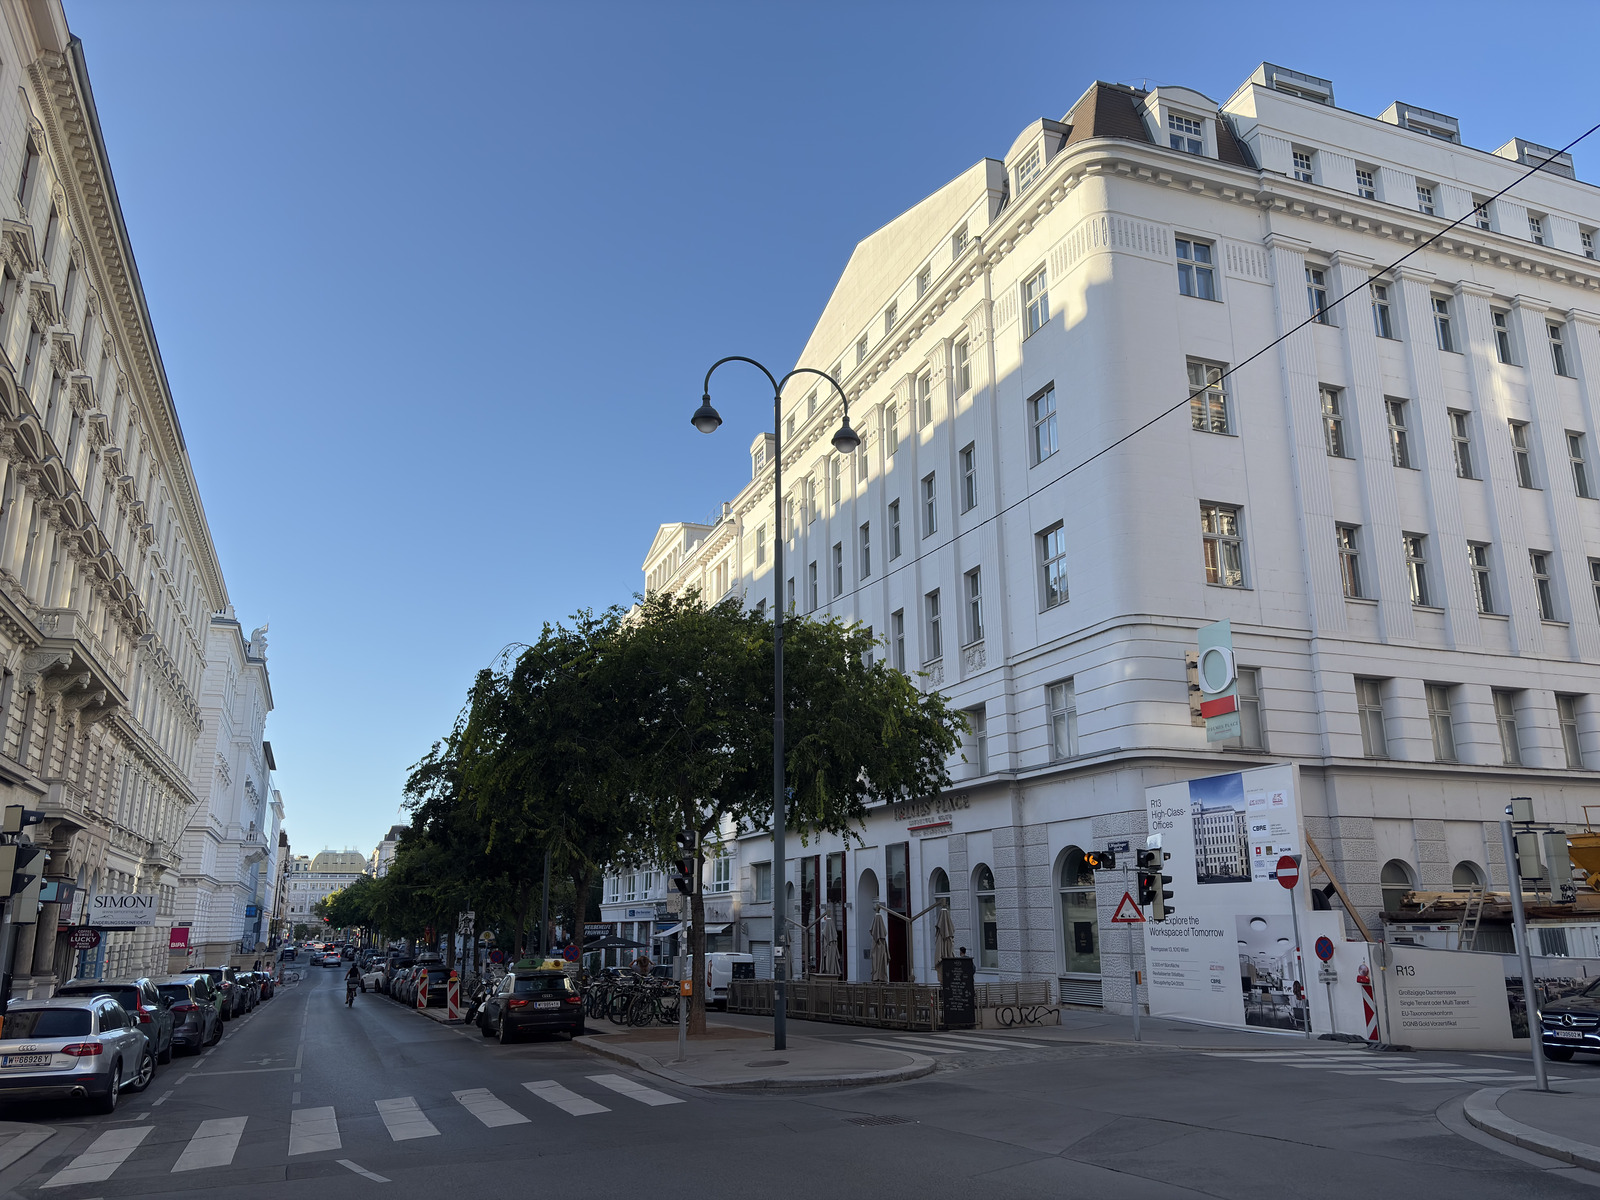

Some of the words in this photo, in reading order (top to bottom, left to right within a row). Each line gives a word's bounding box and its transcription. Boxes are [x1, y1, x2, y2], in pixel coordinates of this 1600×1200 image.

[1225, 721, 1239, 729] PLACE
[936, 794, 970, 814] PLACE
[1150, 799, 1162, 808] R13
[1151, 808, 1186, 820] High-Class-
[1152, 821, 1174, 830] Offices
[94, 895, 154, 909] SIMONI
[1165, 916, 1188, 926] Explore
[1189, 916, 1200, 925] the
[1149, 927, 1183, 938] Workspace
[1184, 927, 1190, 936] of
[1191, 927, 1224, 937] Tomorrow
[1396, 965, 1416, 976] R13
